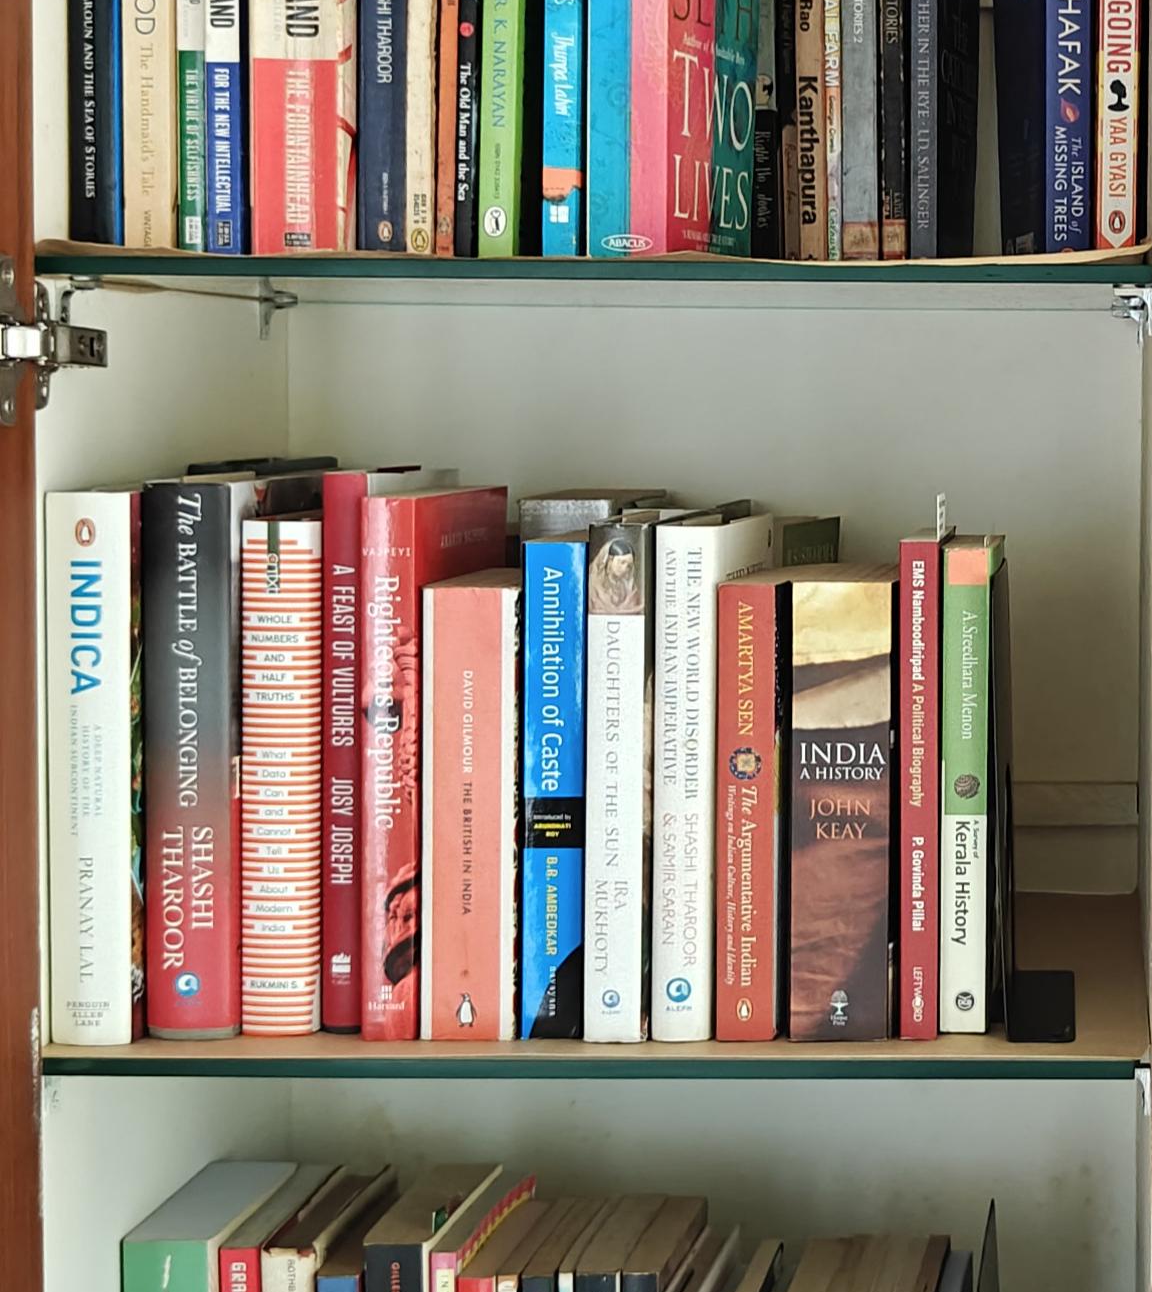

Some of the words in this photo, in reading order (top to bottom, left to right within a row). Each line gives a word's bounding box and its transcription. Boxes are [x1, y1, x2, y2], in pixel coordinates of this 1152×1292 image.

[376, 18, 392, 83] THAROOR
[797, 76, 818, 225] Kanthapura
[1108, 116, 1128, 146] YAA
[1108, 151, 1128, 197] GYASI
[70, 560, 102, 695] INDICA
[369, 575, 400, 708] Righteous
[542, 567, 563, 697] Annihilation
[738, 601, 754, 696] AMARTYA
[541, 704, 563, 726] of
[737, 700, 753, 736] SEN
[370, 716, 399, 829] Republic
[541, 732, 561, 791] Caste
[800, 743, 886, 765] INDIA
[329, 777, 353, 816] JOSY
[191, 826, 214, 928] SHASHI
[330, 824, 354, 884] JOSEPH
[954, 821, 972, 878] Kerala
[161, 826, 184, 969] THAROOR
[951, 881, 971, 945] History
